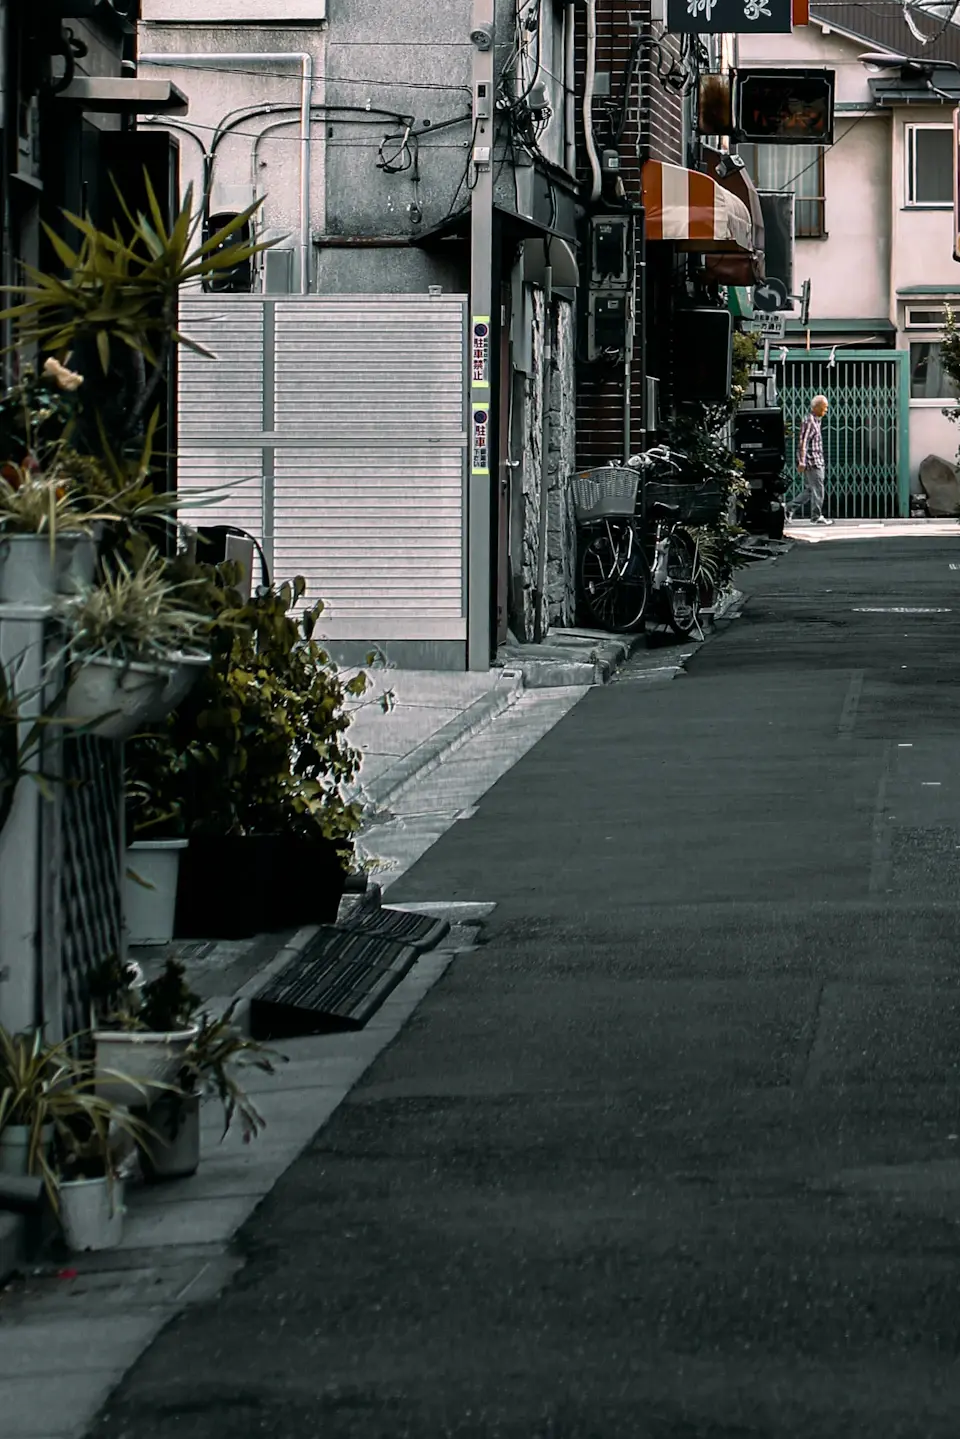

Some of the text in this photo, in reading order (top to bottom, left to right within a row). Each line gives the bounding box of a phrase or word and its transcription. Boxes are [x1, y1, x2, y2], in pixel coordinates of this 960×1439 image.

[473, 338, 483, 380] 駐車禁止
[475, 425, 486, 447] 駐車
